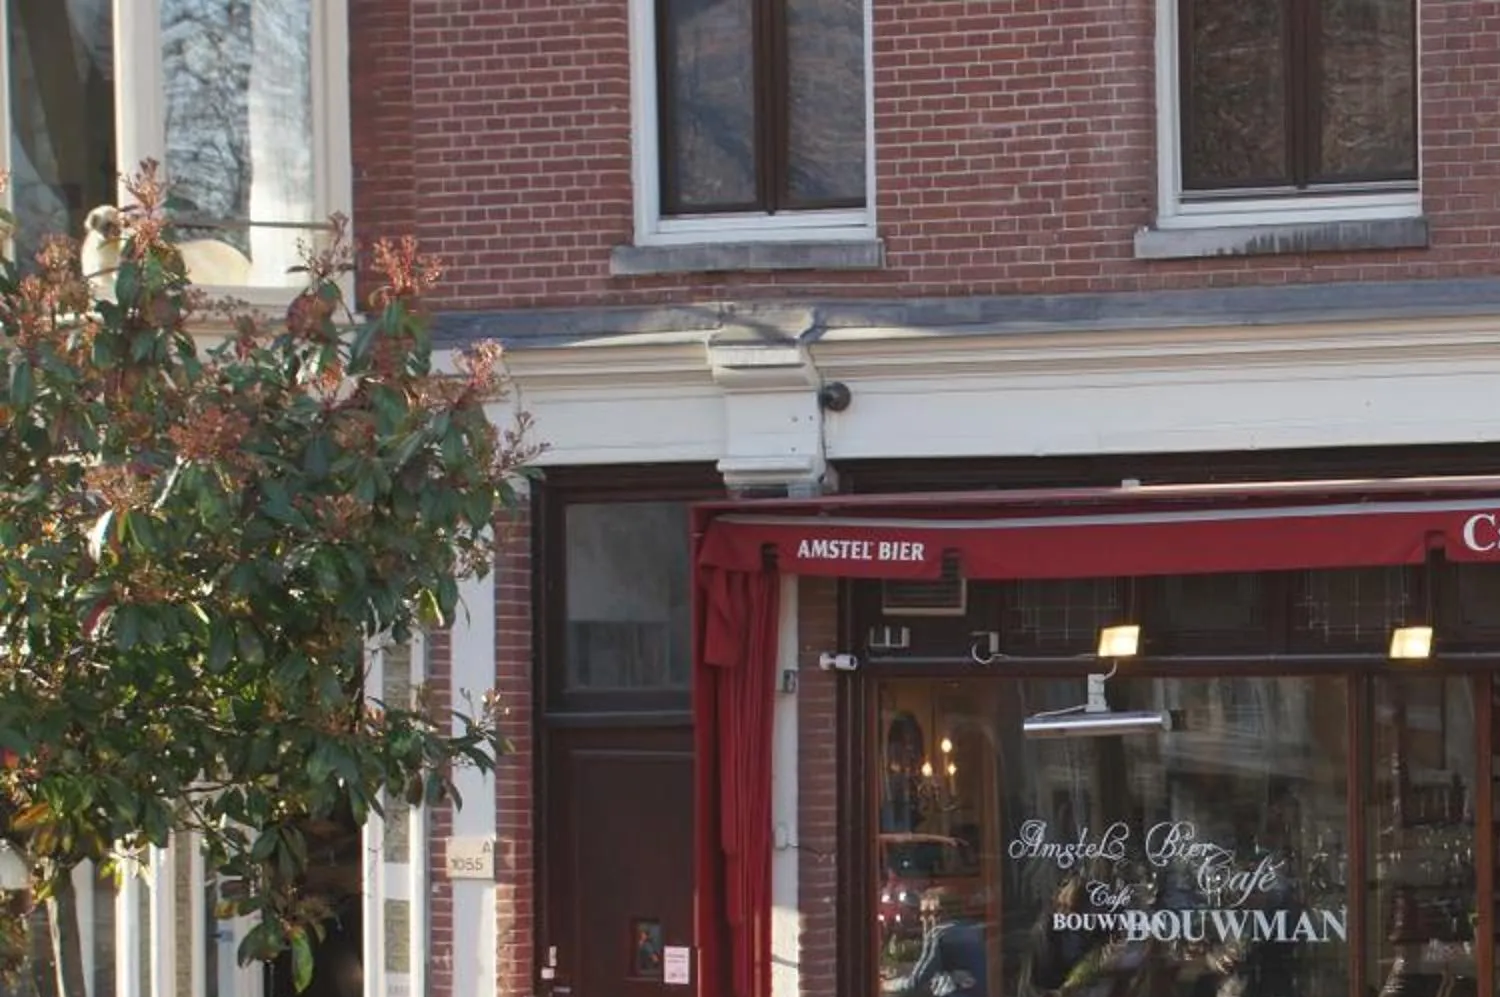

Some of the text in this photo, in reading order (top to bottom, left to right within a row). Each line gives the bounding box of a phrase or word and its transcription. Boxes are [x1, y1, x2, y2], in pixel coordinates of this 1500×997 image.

[797, 539, 926, 562] AMSTEL BIER
[1086, 880, 1134, 912] Café
[1125, 907, 1347, 942] BOUWMAN
